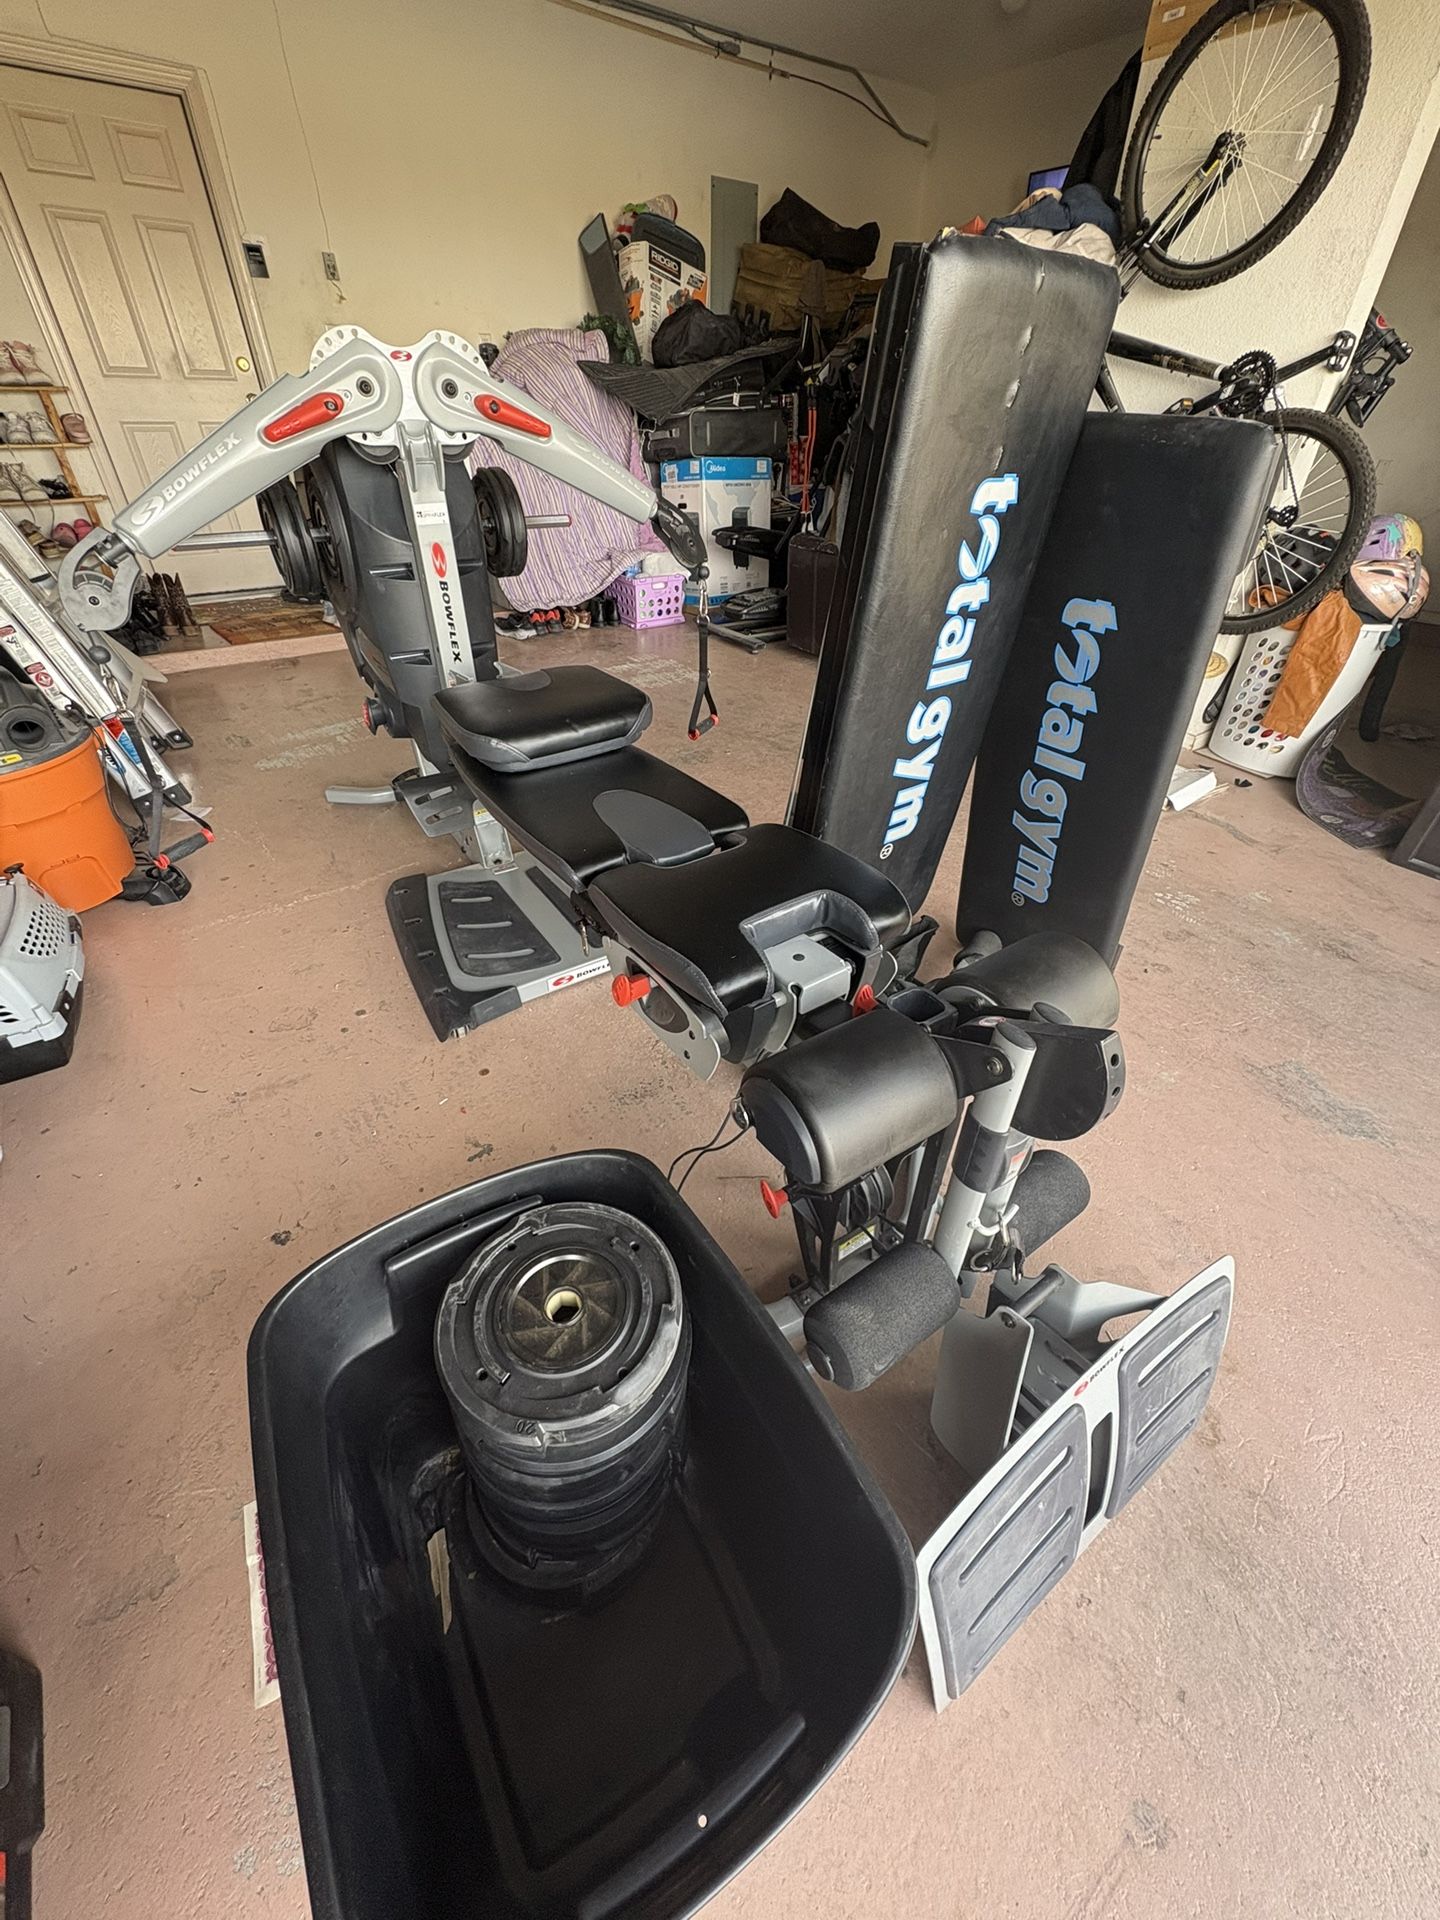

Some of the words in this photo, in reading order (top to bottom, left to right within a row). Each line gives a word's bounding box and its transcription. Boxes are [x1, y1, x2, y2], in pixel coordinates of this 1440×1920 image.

[651, 250, 680, 272] RIDGID
[161, 431, 242, 502] BOWFLEX
[926, 473, 1020, 691] total
[438, 580, 463, 664] BOWFLEX
[1034, 596, 1119, 781] total
[1089, 1345, 1125, 1382] BOWFLEX
